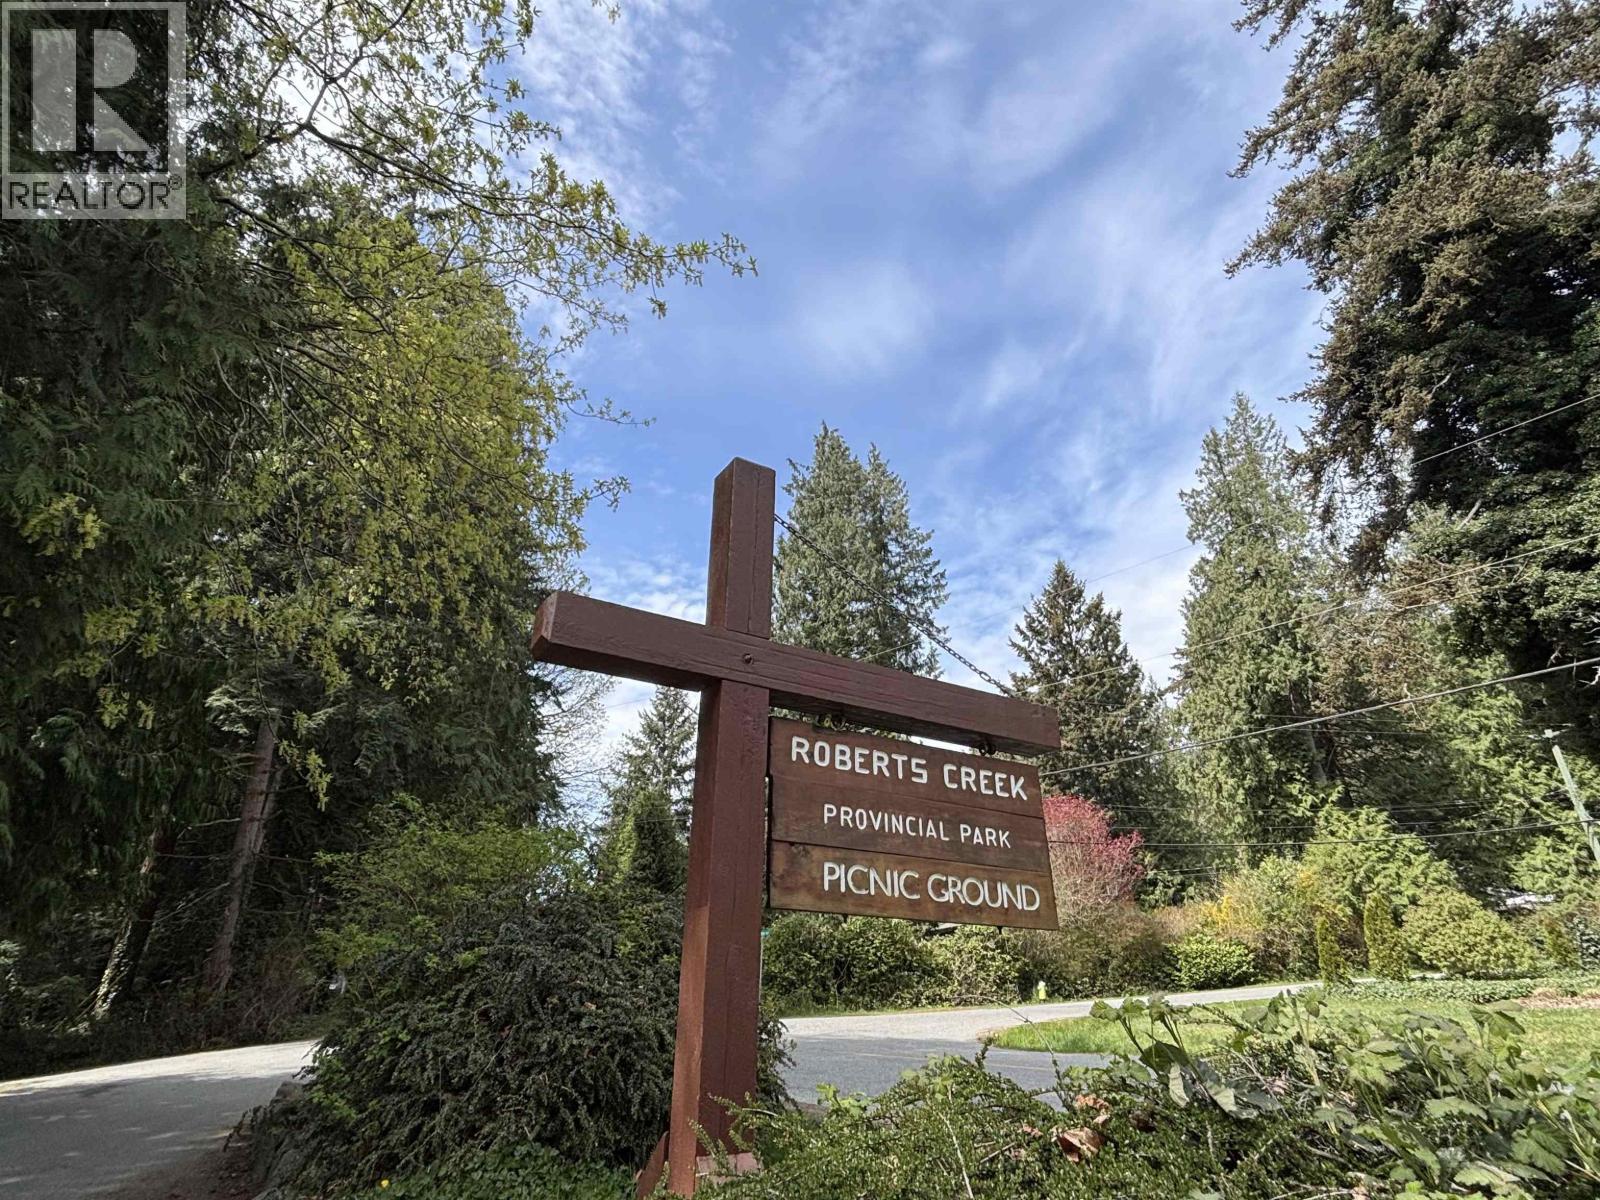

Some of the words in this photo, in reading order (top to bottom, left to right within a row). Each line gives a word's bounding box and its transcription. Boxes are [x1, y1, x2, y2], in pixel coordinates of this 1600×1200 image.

[791, 736, 928, 784] ROBERTS
[943, 763, 1028, 800] CREEK
[823, 803, 950, 842] PROVINCIAL
[960, 823, 1011, 849] PARK
[823, 861, 920, 900] PICNIC
[927, 873, 1041, 911] GROUND
